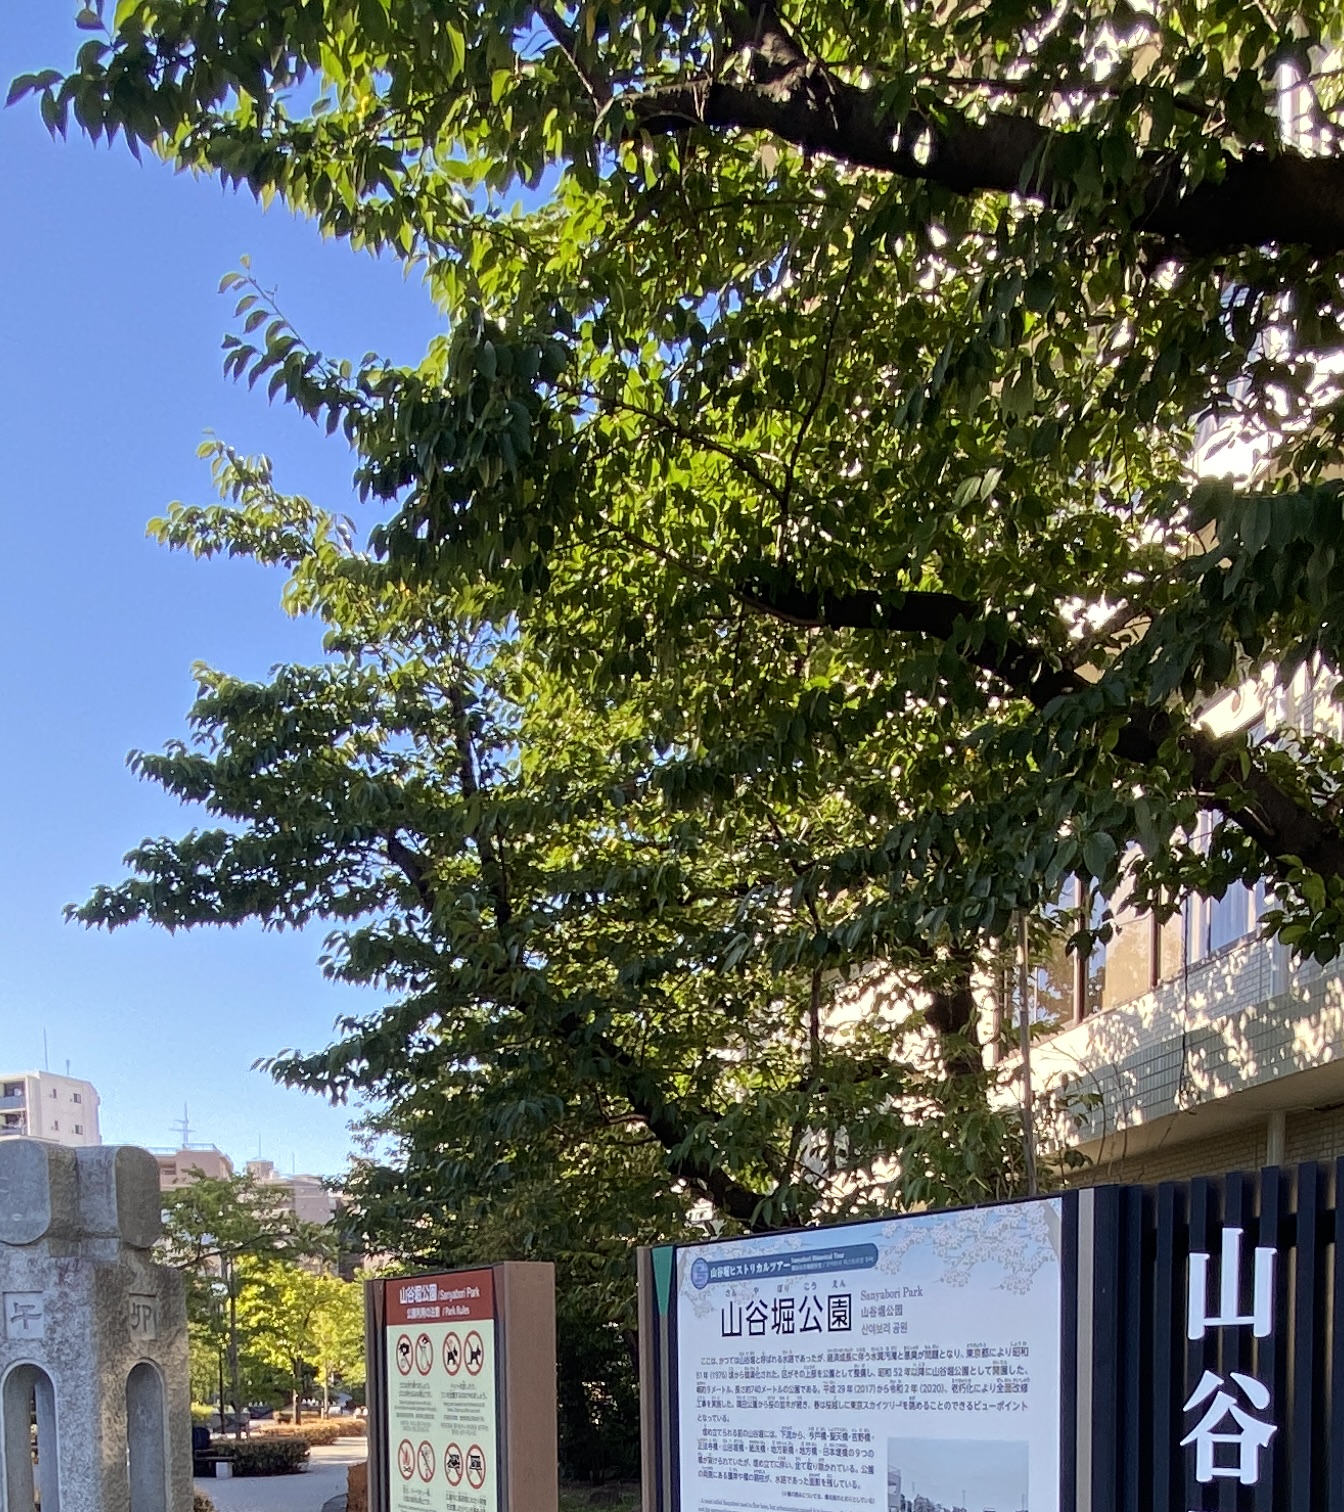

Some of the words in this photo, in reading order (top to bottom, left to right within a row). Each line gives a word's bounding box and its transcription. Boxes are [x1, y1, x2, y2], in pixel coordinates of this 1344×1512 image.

[710, 1260, 791, 1279] 山谷堀ヒストリカルツアー
[399, 1283, 437, 1304] 山谷堀公園
[466, 1286, 480, 1298] Park
[860, 1288, 901, 1302] Sanyabori
[903, 1285, 923, 1298] Park
[10, 1302, 42, 1330] 午
[721, 1293, 852, 1338] 山谷堀公園
[893, 1321, 908, 1334] 공원
[697, 1414, 730, 1423] となっている。
